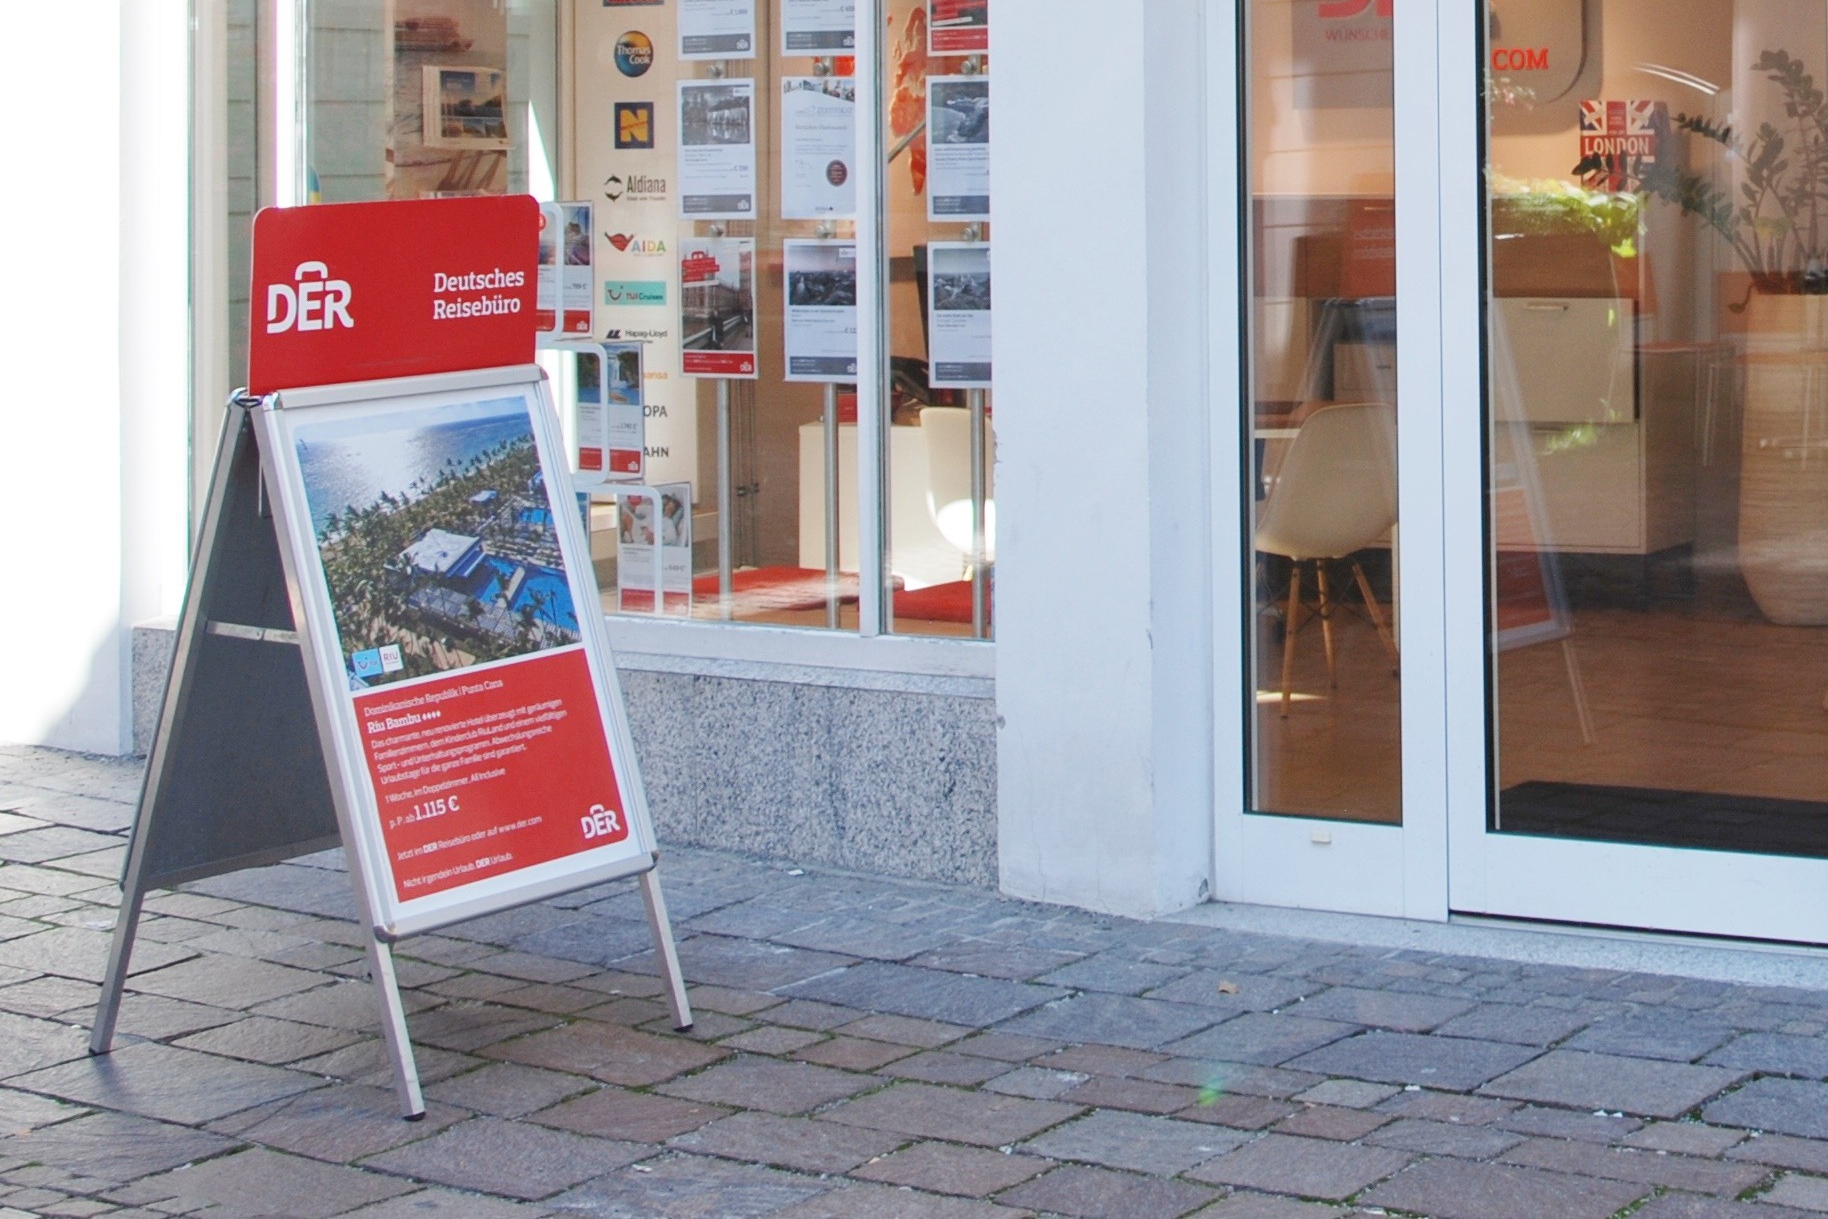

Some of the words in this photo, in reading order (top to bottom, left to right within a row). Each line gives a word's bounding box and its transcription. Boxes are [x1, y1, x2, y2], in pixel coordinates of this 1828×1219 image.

[616, 45, 651, 56] Thomas
[628, 54, 650, 66] Cook
[1584, 137, 1649, 155] LONDON
[626, 175, 666, 193] Aldiana
[631, 240, 667, 252] AIDA
[433, 268, 525, 293] Deutsches
[267, 270, 355, 334] DER
[432, 295, 521, 320] Reisebüro
[367, 721, 386, 734] Riu
[385, 713, 422, 730] Bambu
[414, 799, 446, 821] 1.115
[448, 795, 460, 811] €
[580, 806, 621, 840] DER
